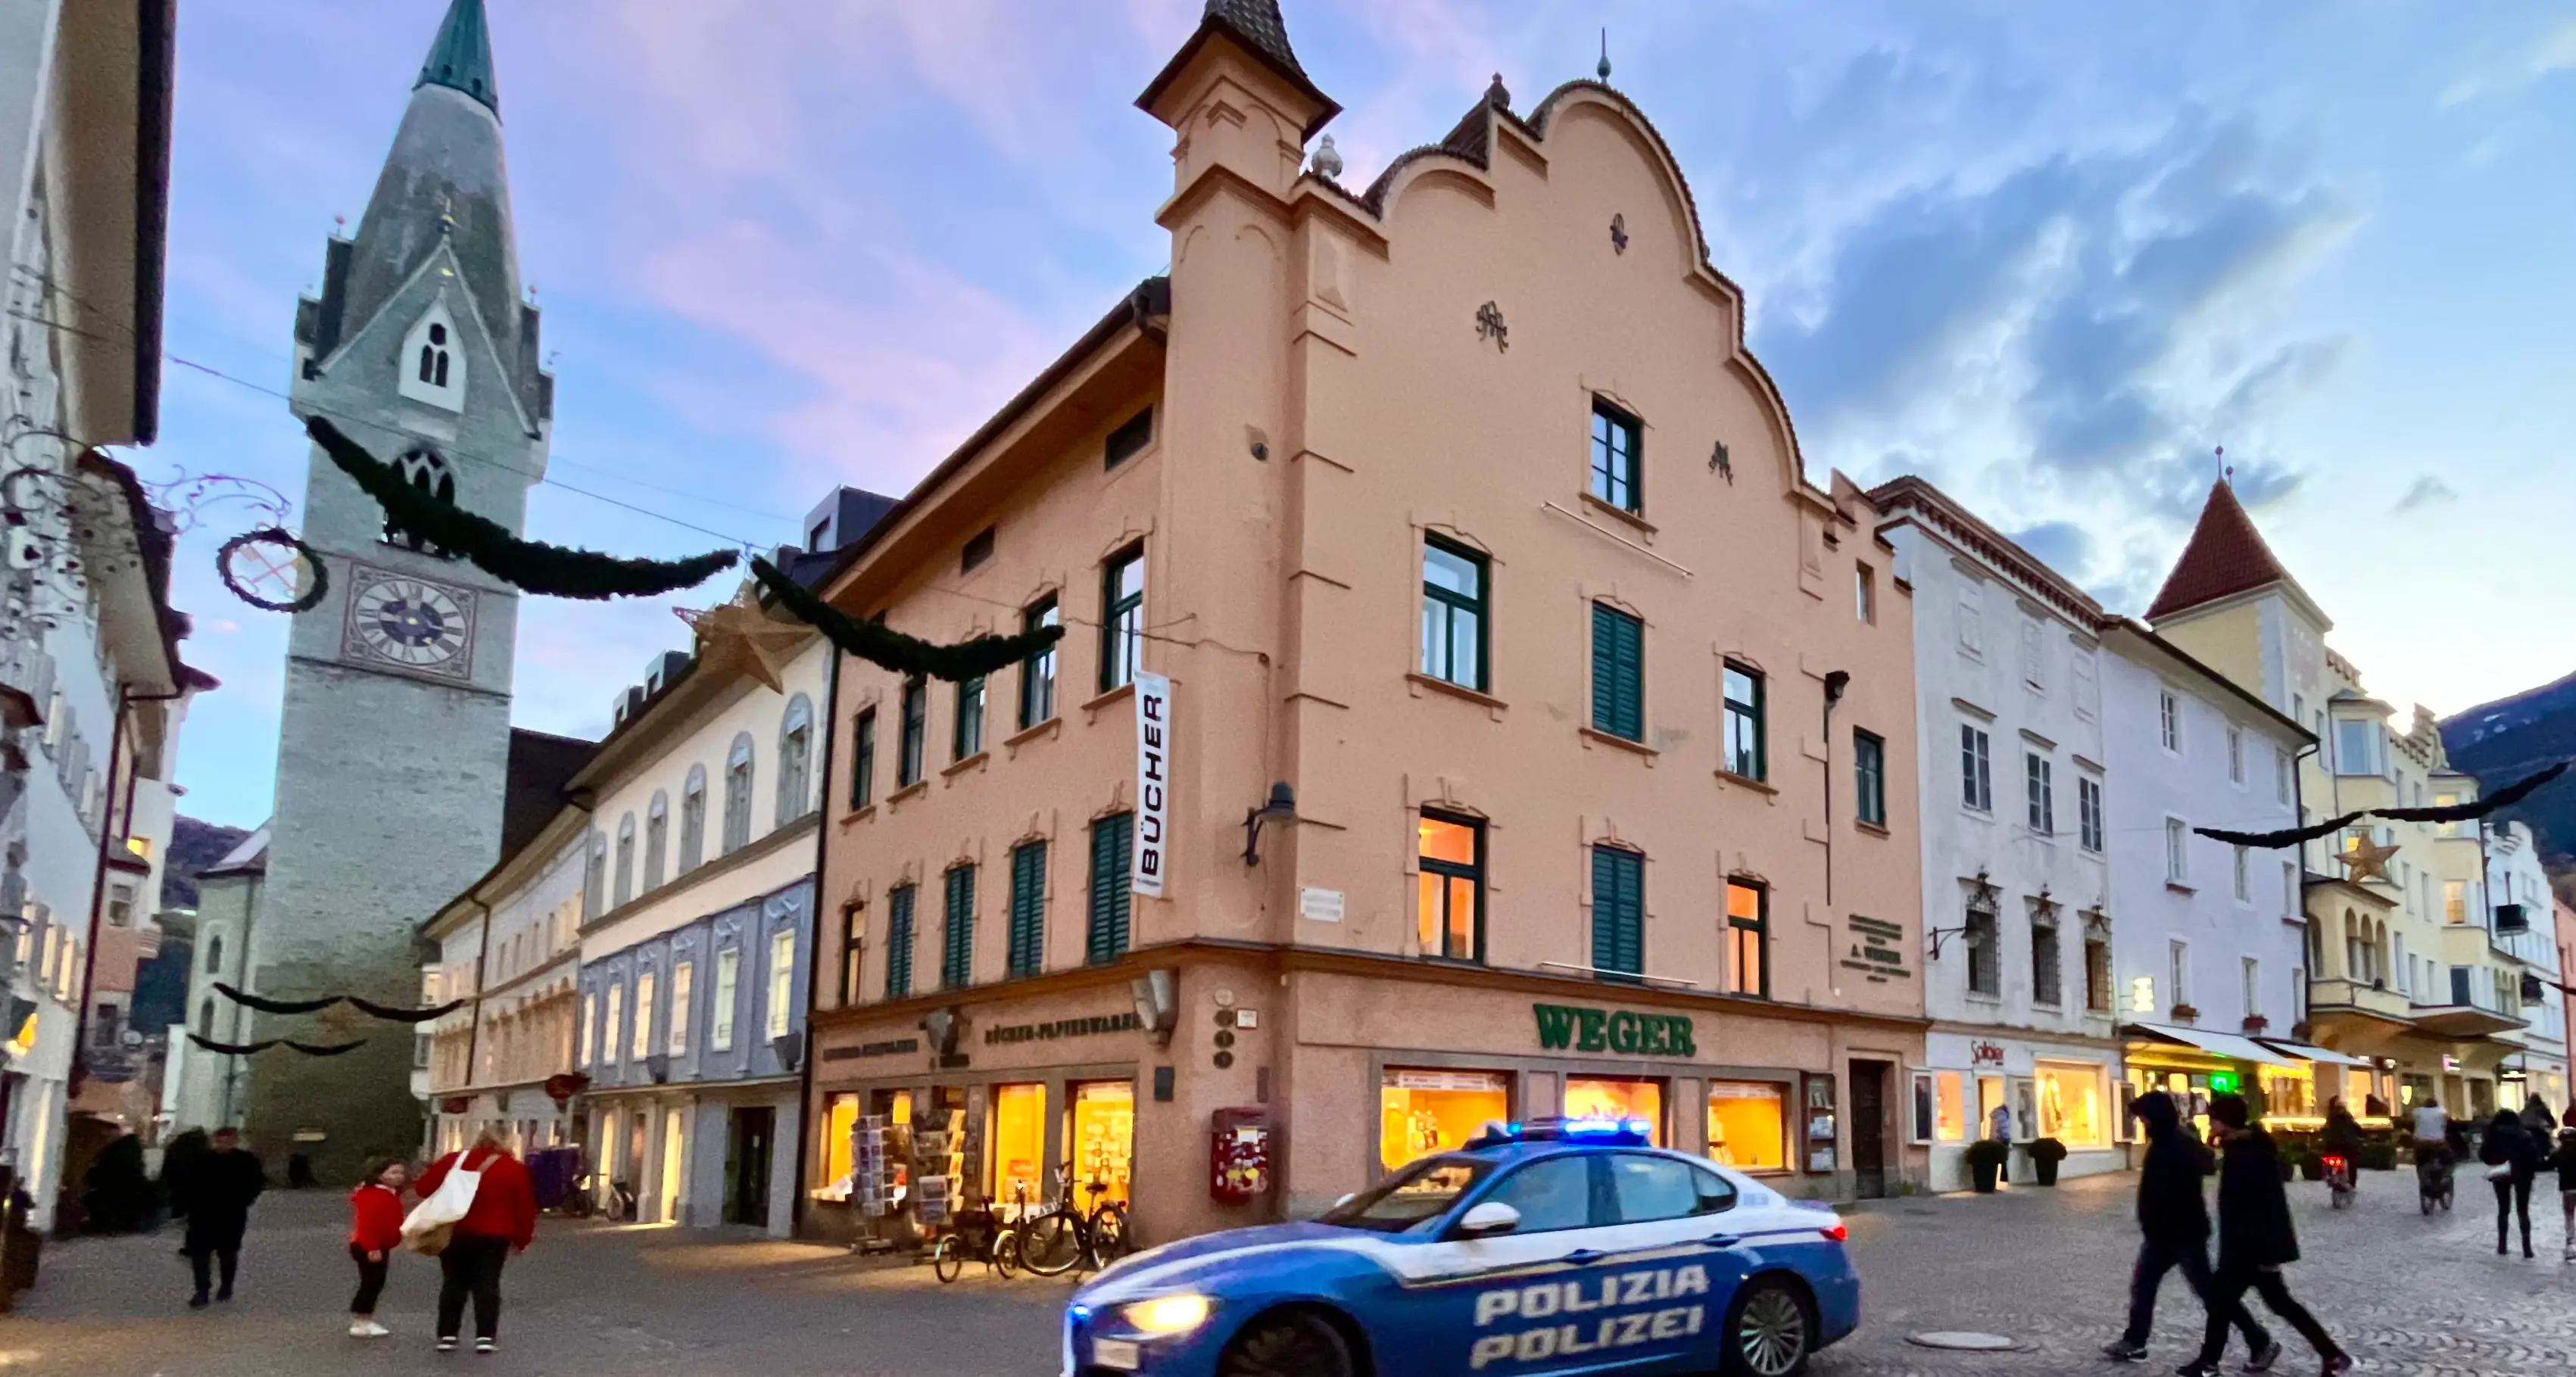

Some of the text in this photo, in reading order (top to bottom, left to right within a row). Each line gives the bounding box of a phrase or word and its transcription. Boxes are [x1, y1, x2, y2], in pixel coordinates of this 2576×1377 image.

[1140, 694, 1162, 876] BÜCHER
[1533, 1003, 1696, 1057] WEGER
[1474, 1263, 1709, 1326] POLIZIA
[1469, 1304, 1704, 1369] POLIZEI
